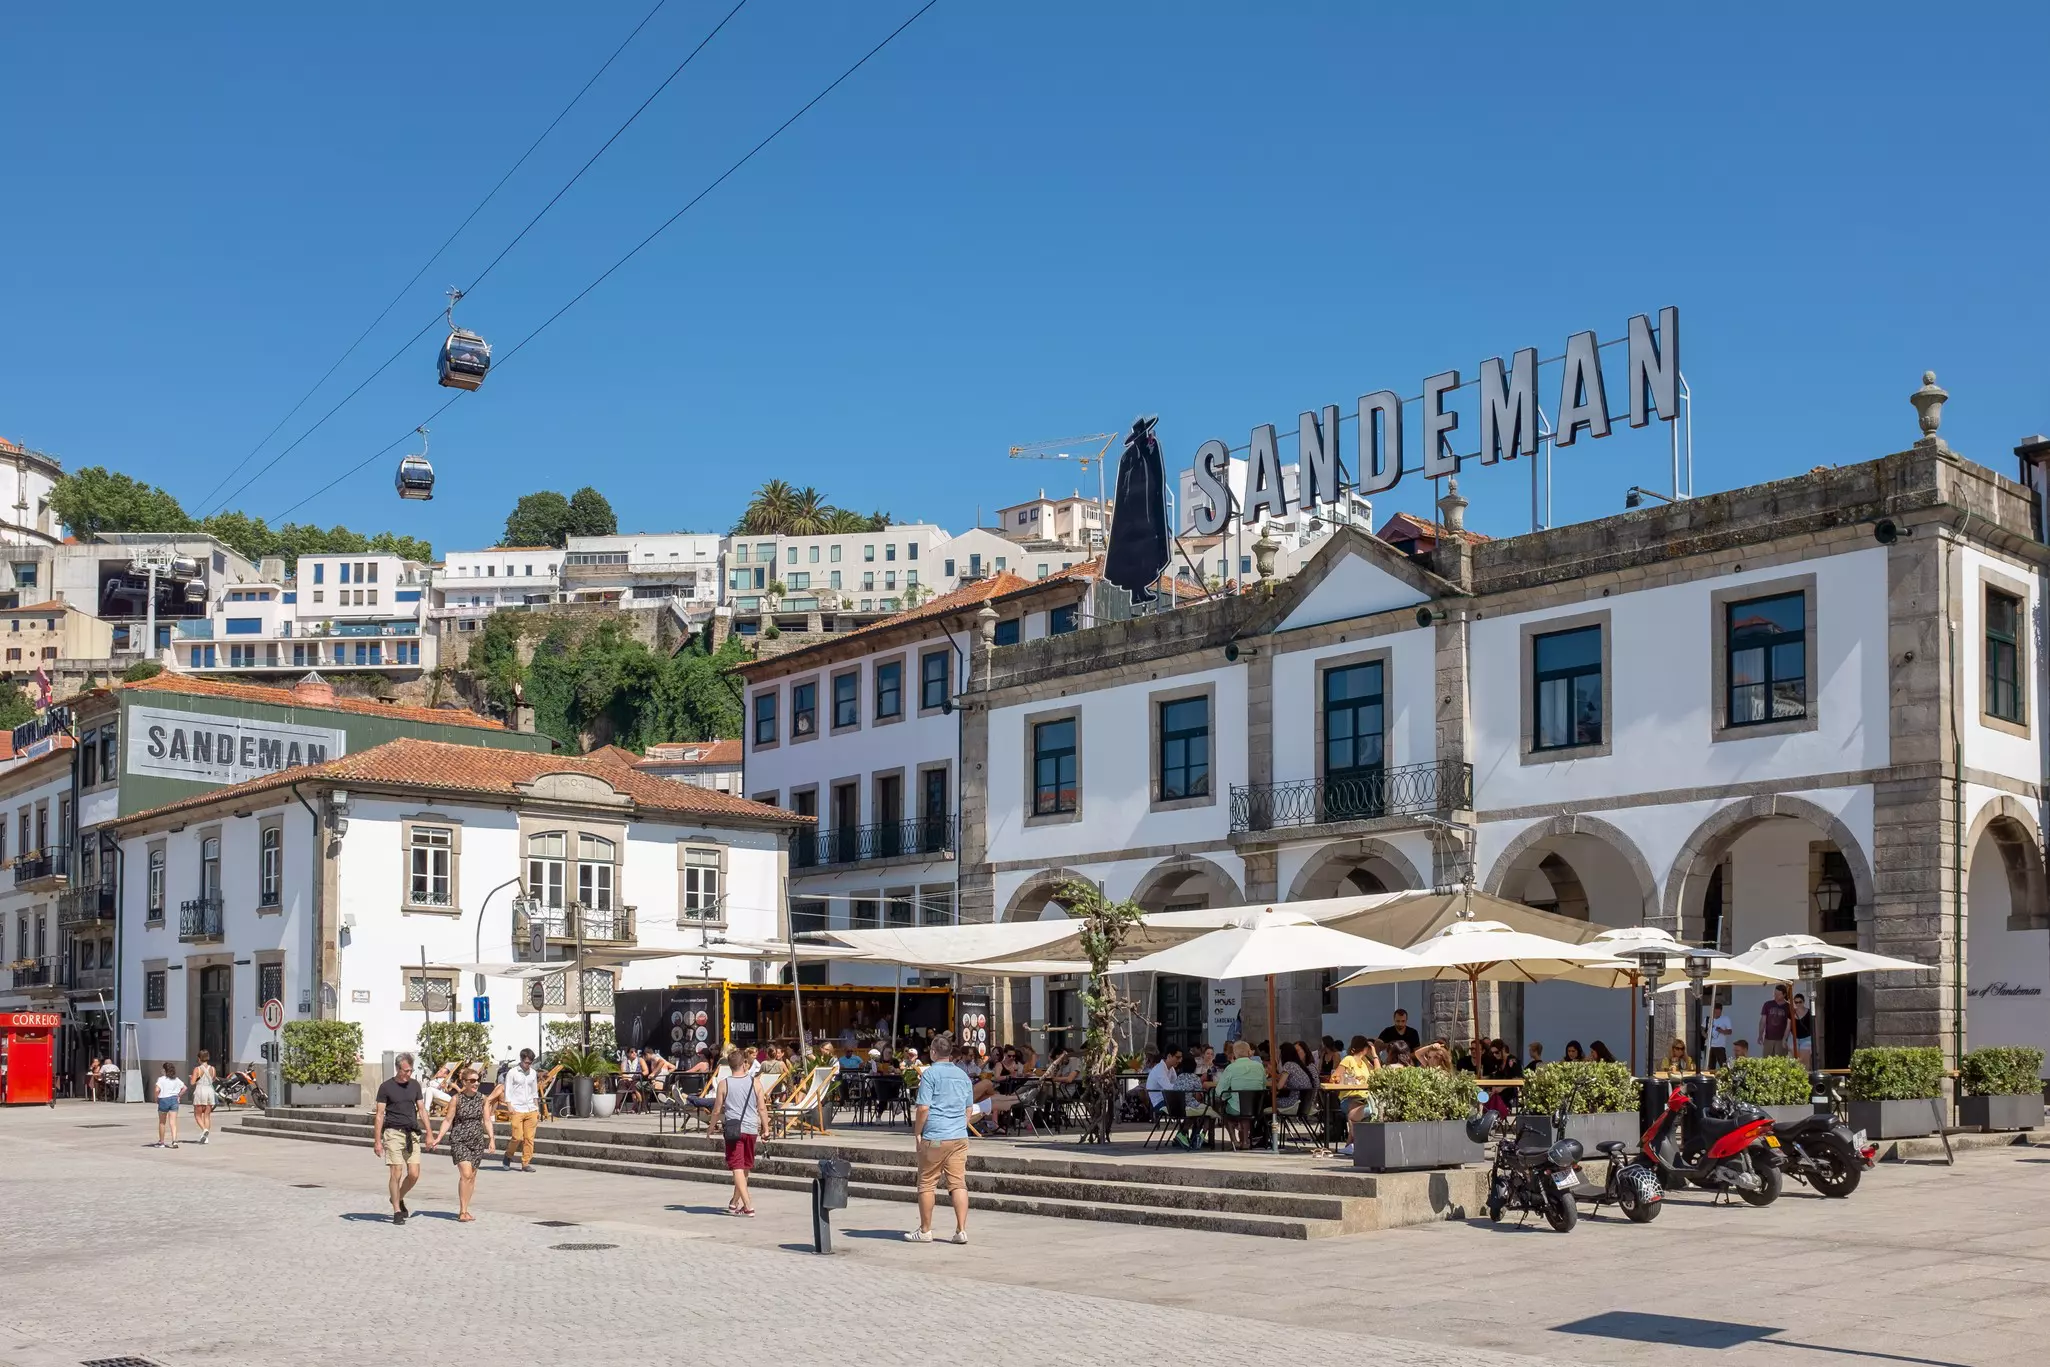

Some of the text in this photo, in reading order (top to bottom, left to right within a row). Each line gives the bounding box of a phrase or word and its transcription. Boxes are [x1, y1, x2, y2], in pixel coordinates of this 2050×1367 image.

[1194, 306, 1679, 535] SANDEMAN
[147, 725, 328, 770] SANDEMAN
[1979, 983, 1994, 998] of
[1990, 981, 2041, 997] Sandeman
[1214, 998, 1235, 1006] HOUSE
[12, 1014, 58, 1026] CORREIOS
